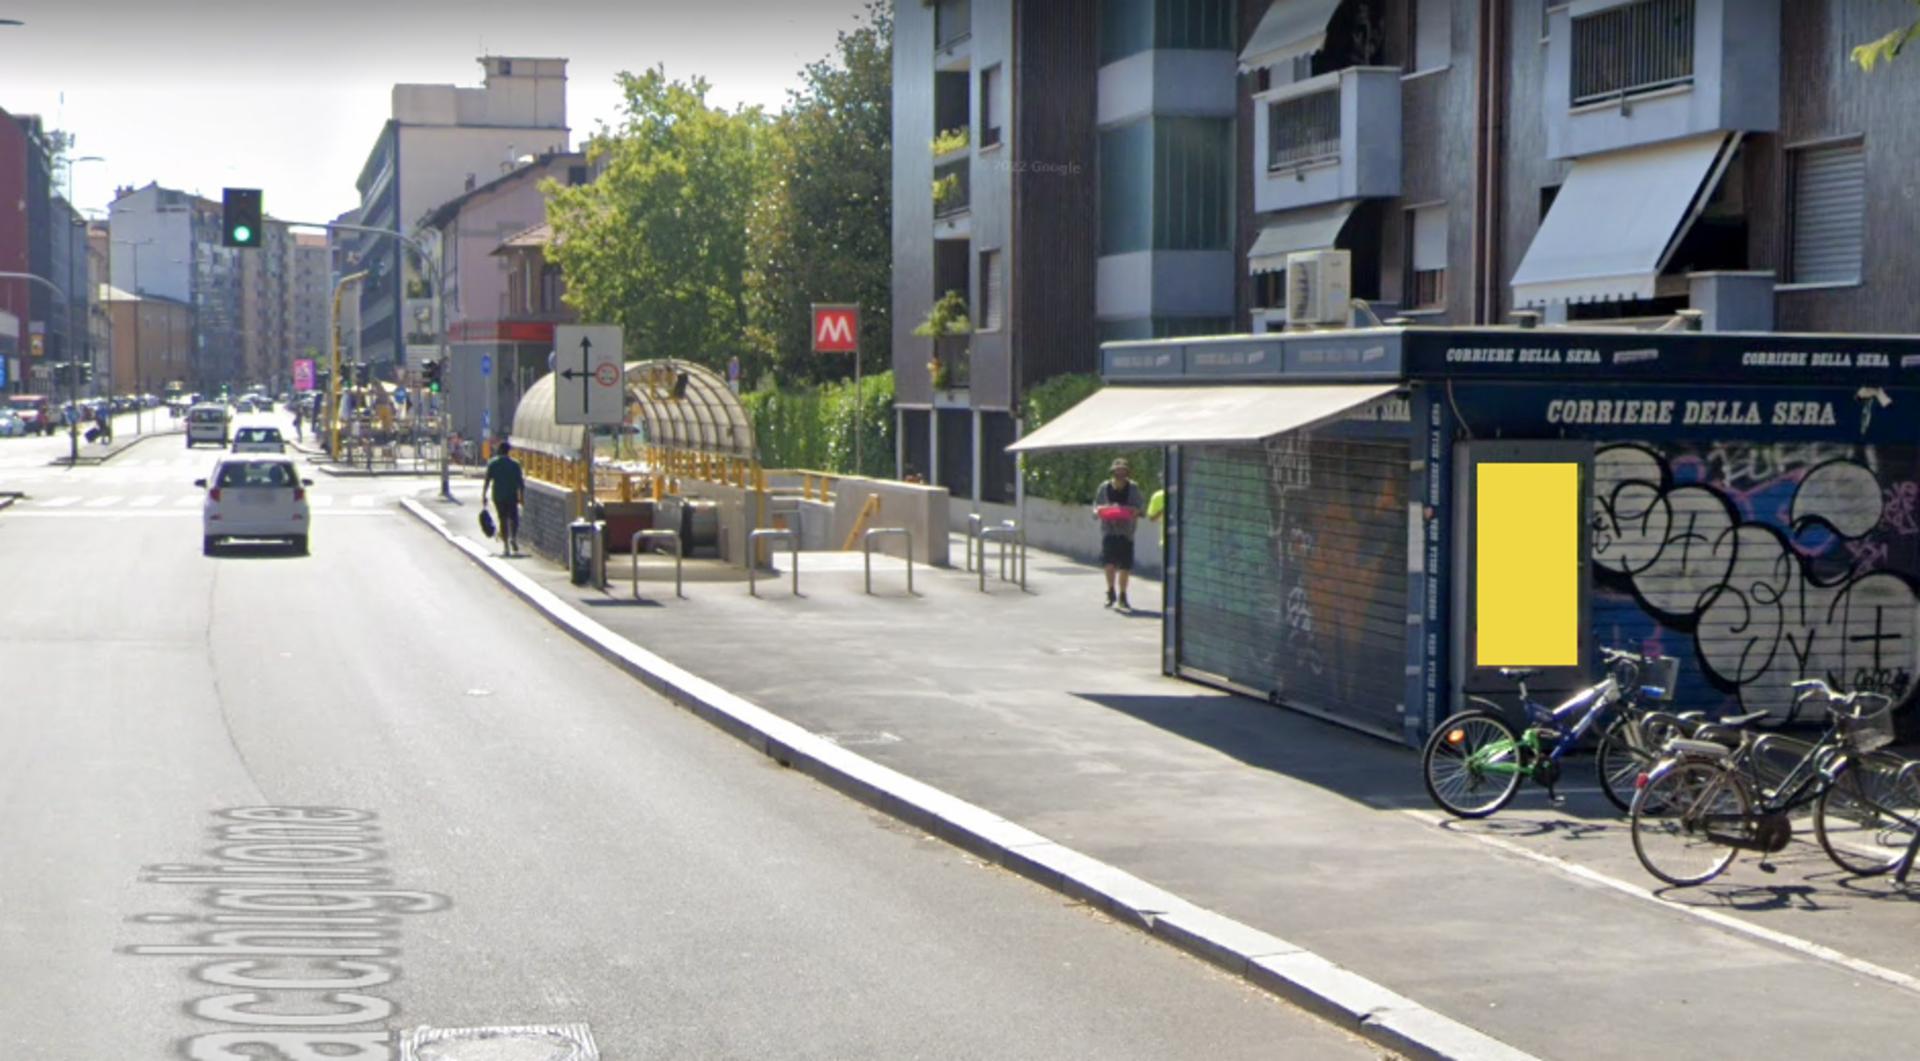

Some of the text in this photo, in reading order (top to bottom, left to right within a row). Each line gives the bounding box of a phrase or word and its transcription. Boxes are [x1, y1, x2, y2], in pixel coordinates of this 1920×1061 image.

[817, 315, 853, 343] M
[1446, 348, 1514, 363] CORRIERE
[1518, 349, 1562, 363] DELLA
[1566, 349, 1602, 363] SERA
[1742, 352, 1807, 366] CORRIERE
[1811, 353, 1852, 366] DELLA
[1856, 354, 1890, 367] SERA
[1546, 399, 1836, 425] CORRIERE DELLA SERA
